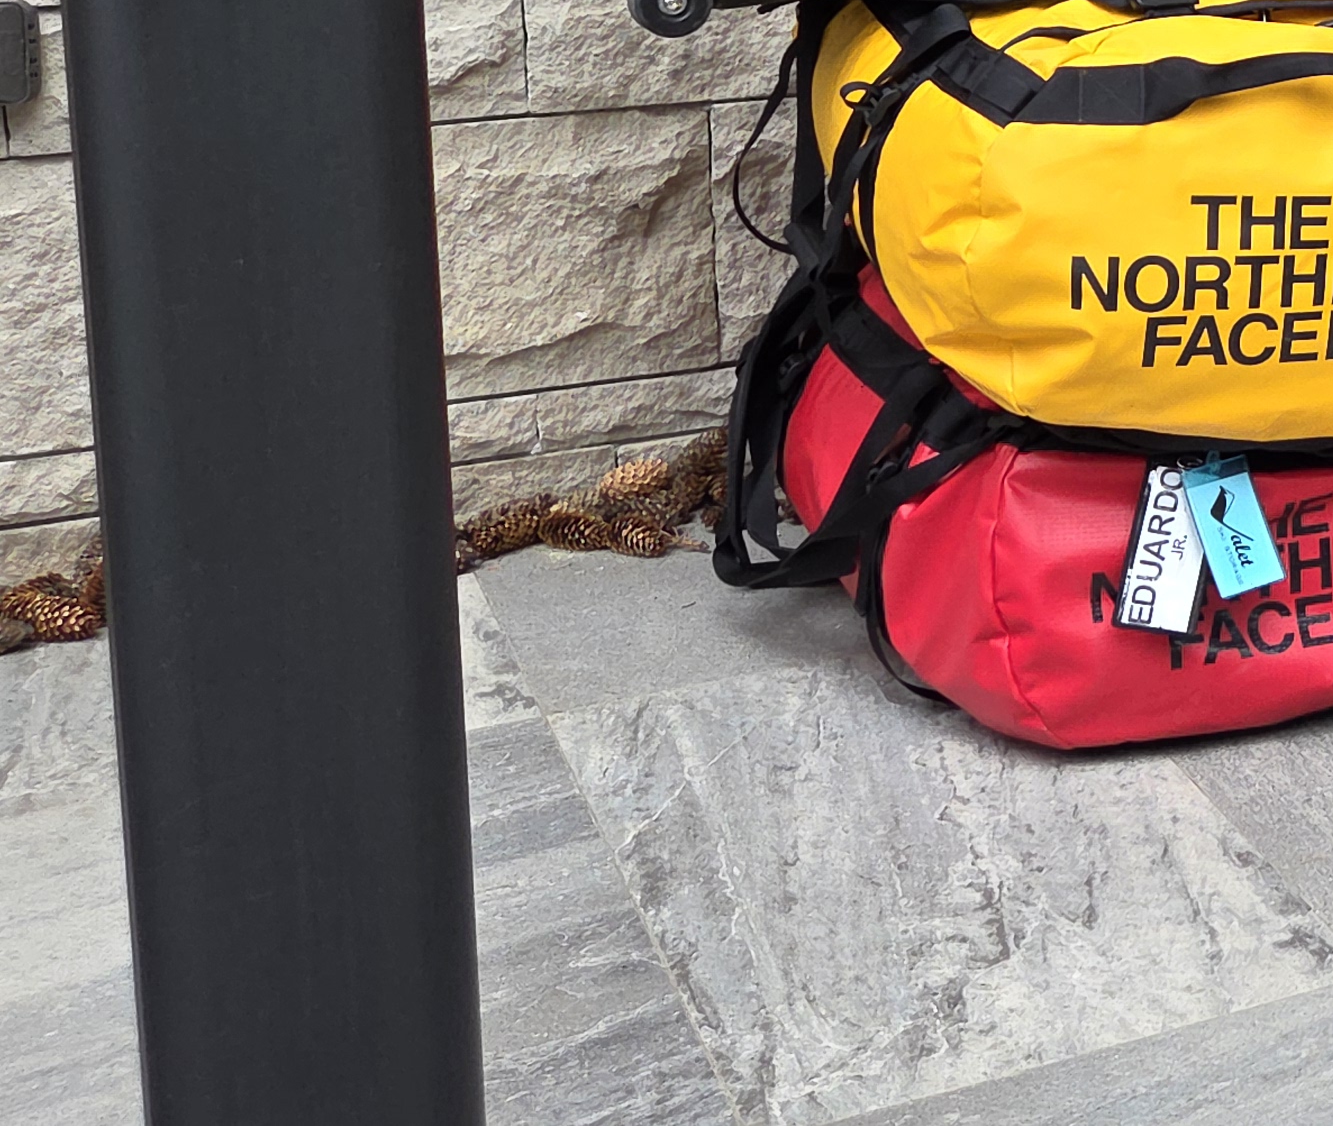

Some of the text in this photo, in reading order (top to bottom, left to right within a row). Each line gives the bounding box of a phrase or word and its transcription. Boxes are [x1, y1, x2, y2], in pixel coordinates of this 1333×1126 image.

[1190, 195, 1333, 251] THE
[1070, 253, 1328, 313] NORTH
[1141, 311, 1324, 368] FACE
[1128, 468, 1184, 625] EDUARDO
[1171, 534, 1188, 561] JR.
